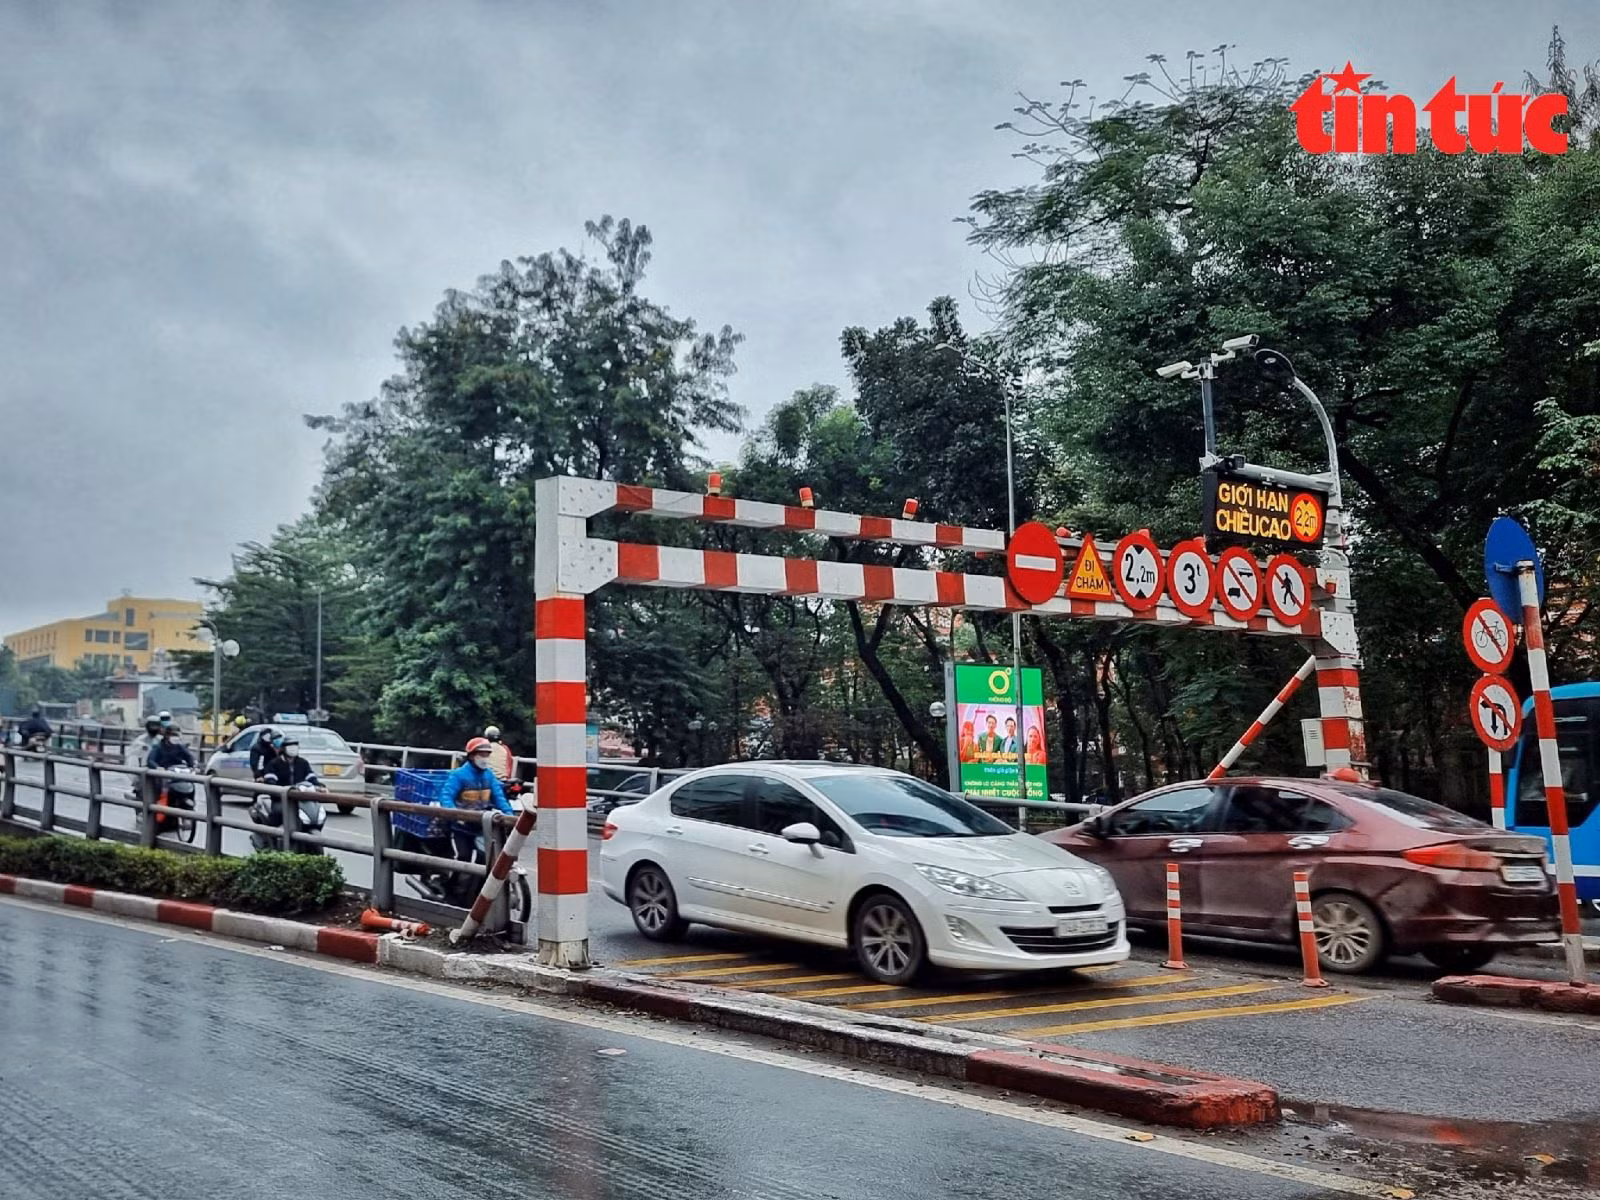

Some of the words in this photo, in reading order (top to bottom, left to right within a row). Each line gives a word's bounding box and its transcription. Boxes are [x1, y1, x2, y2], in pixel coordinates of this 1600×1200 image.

[1218, 483, 1253, 507] GIỚI
[1256, 489, 1289, 513] HẠN
[1076, 575, 1104, 592] CHẬM
